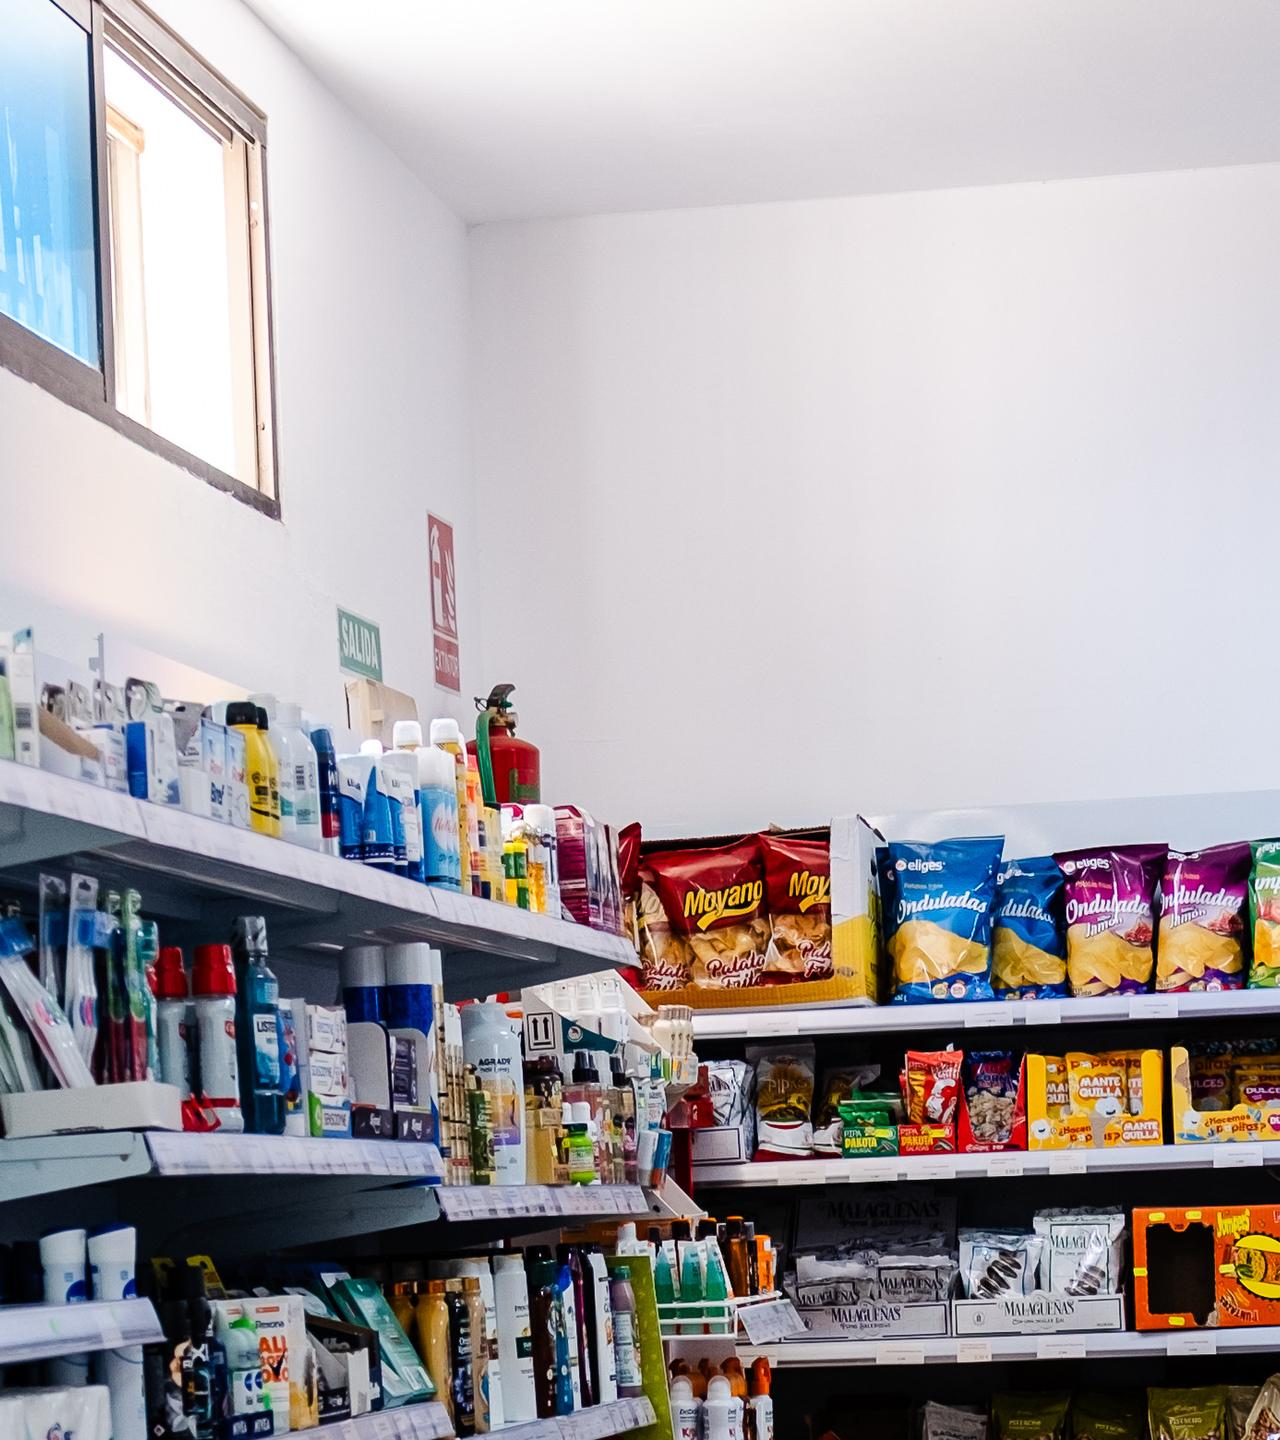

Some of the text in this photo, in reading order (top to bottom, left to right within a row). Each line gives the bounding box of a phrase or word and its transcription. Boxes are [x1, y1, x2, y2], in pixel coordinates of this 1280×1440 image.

[340, 615, 380, 671] SALIDA
[907, 858, 944, 874] eliges
[683, 878, 764, 918] Moyano
[1080, 1075, 1121, 1088] MANTE
[1078, 1086, 1122, 1099] QUILLA
[899, 1127, 919, 1138] PIPA
[1123, 1120, 1159, 1132] MANTE
[844, 1129, 863, 1139] PIPA
[1122, 1130, 1160, 1141] QUILLA
[844, 1137, 878, 1149] DAKOTA
[900, 1136, 931, 1147] DAKOTA
[831, 1305, 902, 1324] MALAGUEÑAS
[1003, 1300, 1075, 1317] MALAGUEÑAS
